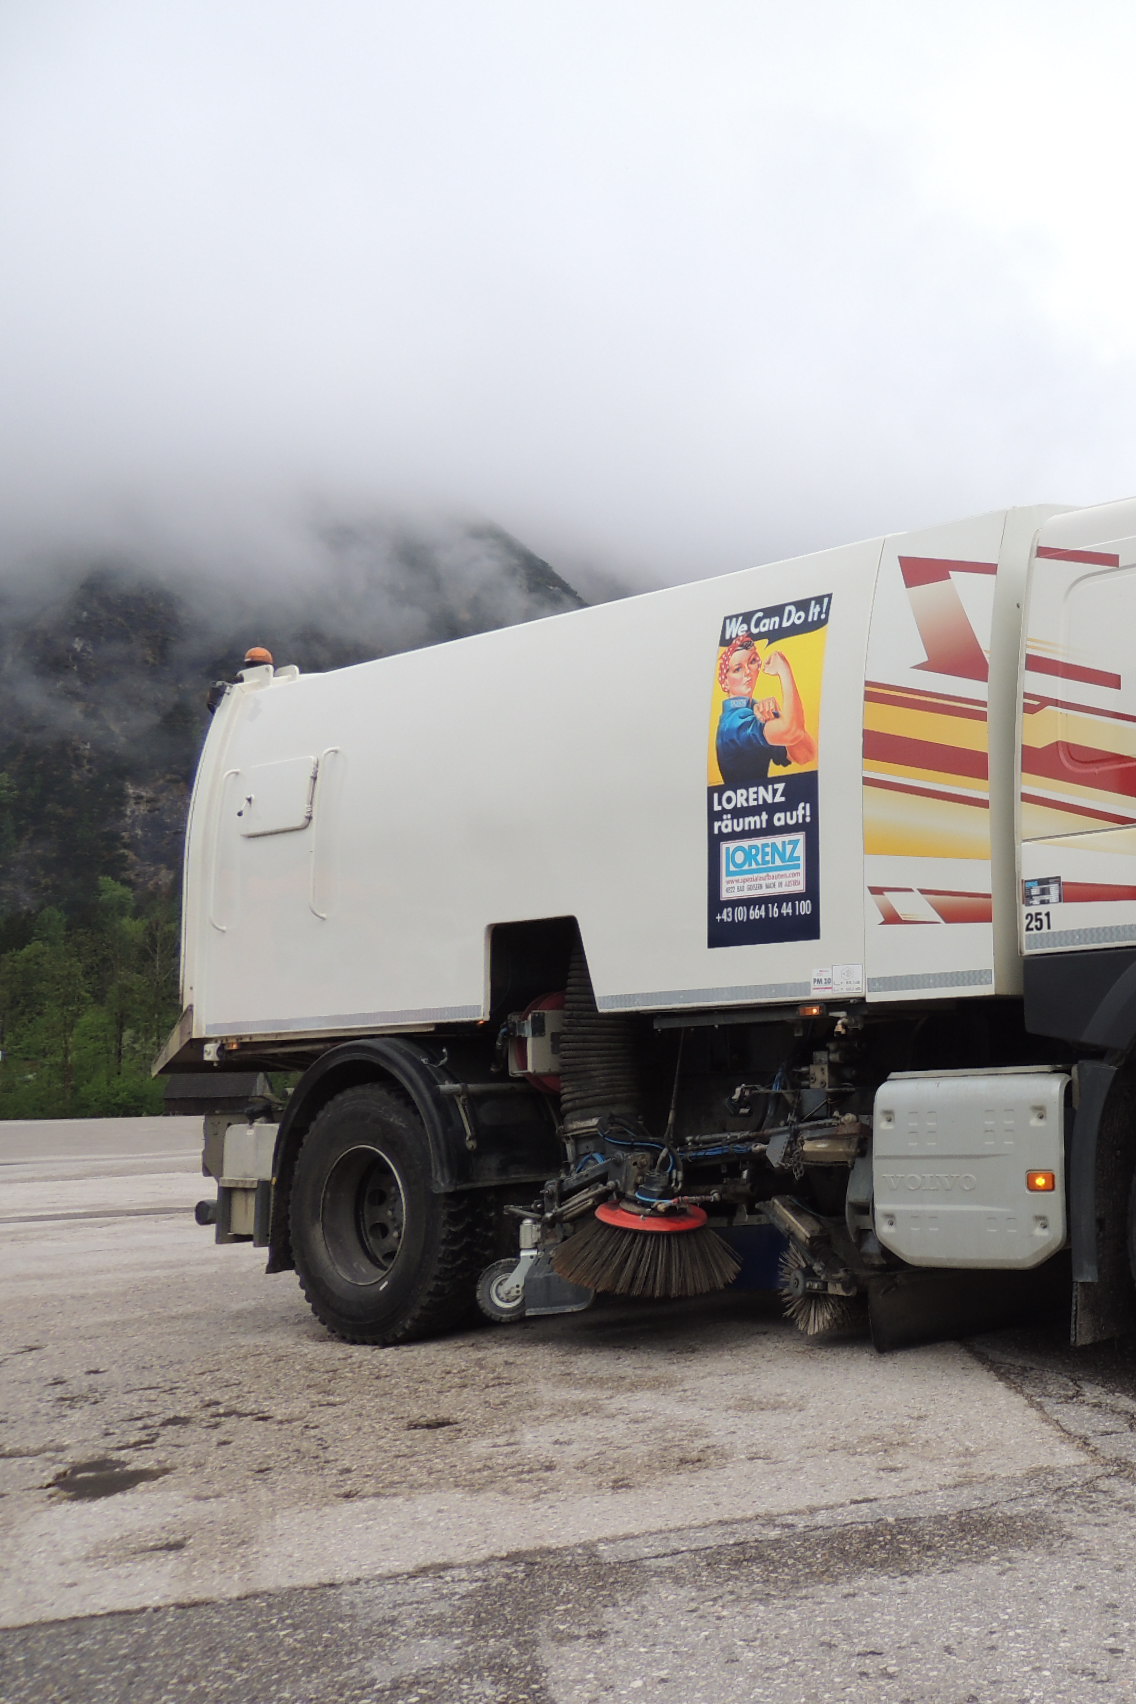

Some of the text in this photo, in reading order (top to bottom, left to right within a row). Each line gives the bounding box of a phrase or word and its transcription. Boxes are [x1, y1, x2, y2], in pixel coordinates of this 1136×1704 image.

[725, 598, 829, 640] We Can Do It!
[713, 782, 786, 812] LORENZ
[714, 802, 811, 834] räumt auf!
[726, 838, 800, 878] LORENZ
[716, 900, 812, 923] +43 (0) 664 16 44 100
[1025, 911, 1052, 932] 251
[882, 1173, 977, 1192] VOLVO
